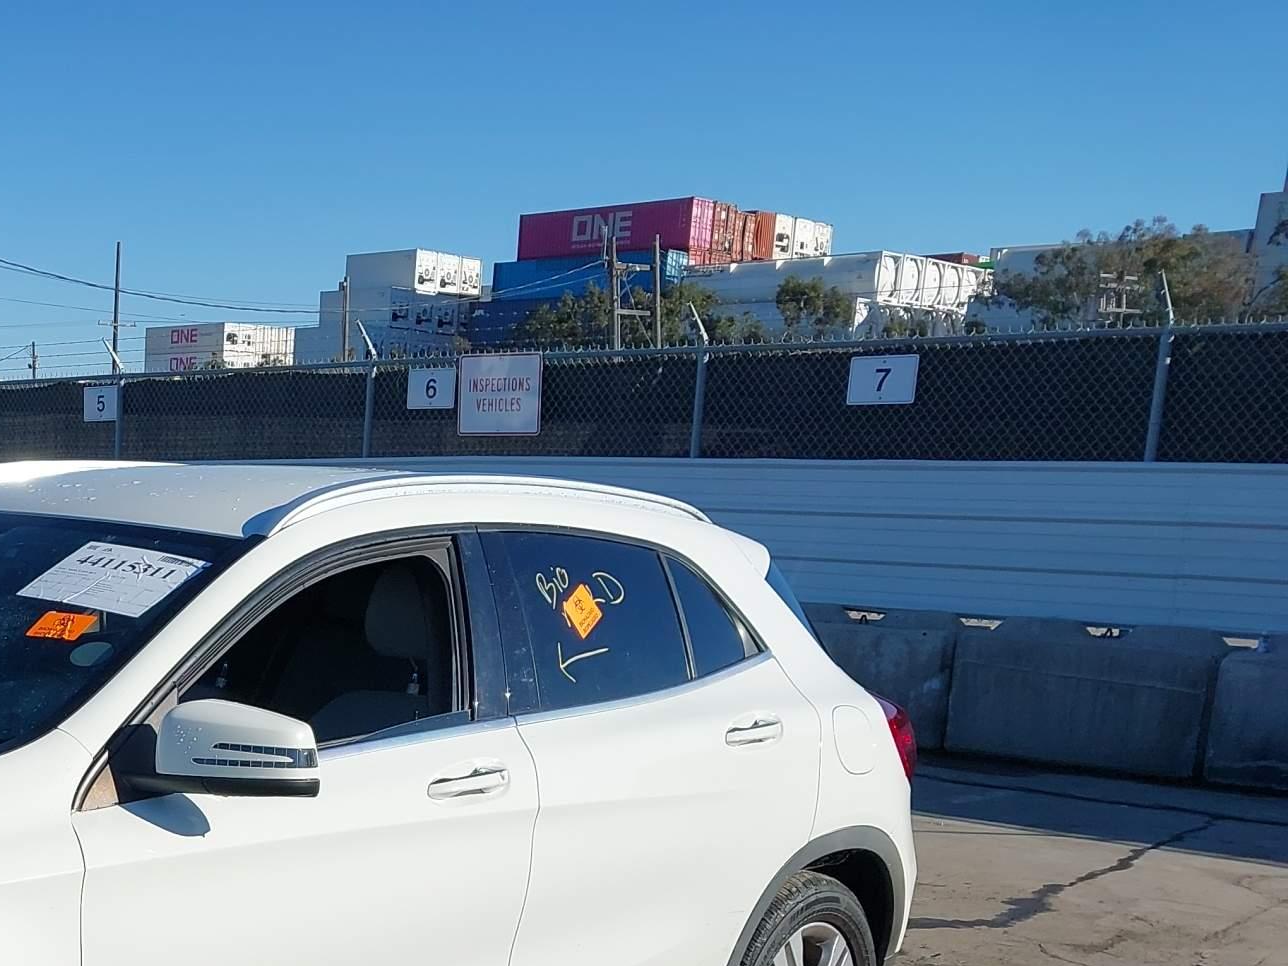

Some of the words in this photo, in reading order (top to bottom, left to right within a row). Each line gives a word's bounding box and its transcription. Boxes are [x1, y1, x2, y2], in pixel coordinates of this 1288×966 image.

[572, 211, 632, 241] ONE
[170, 328, 198, 344] ONE
[169, 356, 197, 371] ONE
[425, 378, 437, 399] 6
[468, 377, 531, 393] INSPECTIONS
[875, 368, 892, 392] 7
[96, 394, 106, 412] 5
[476, 398, 521, 412] VEHICLES
